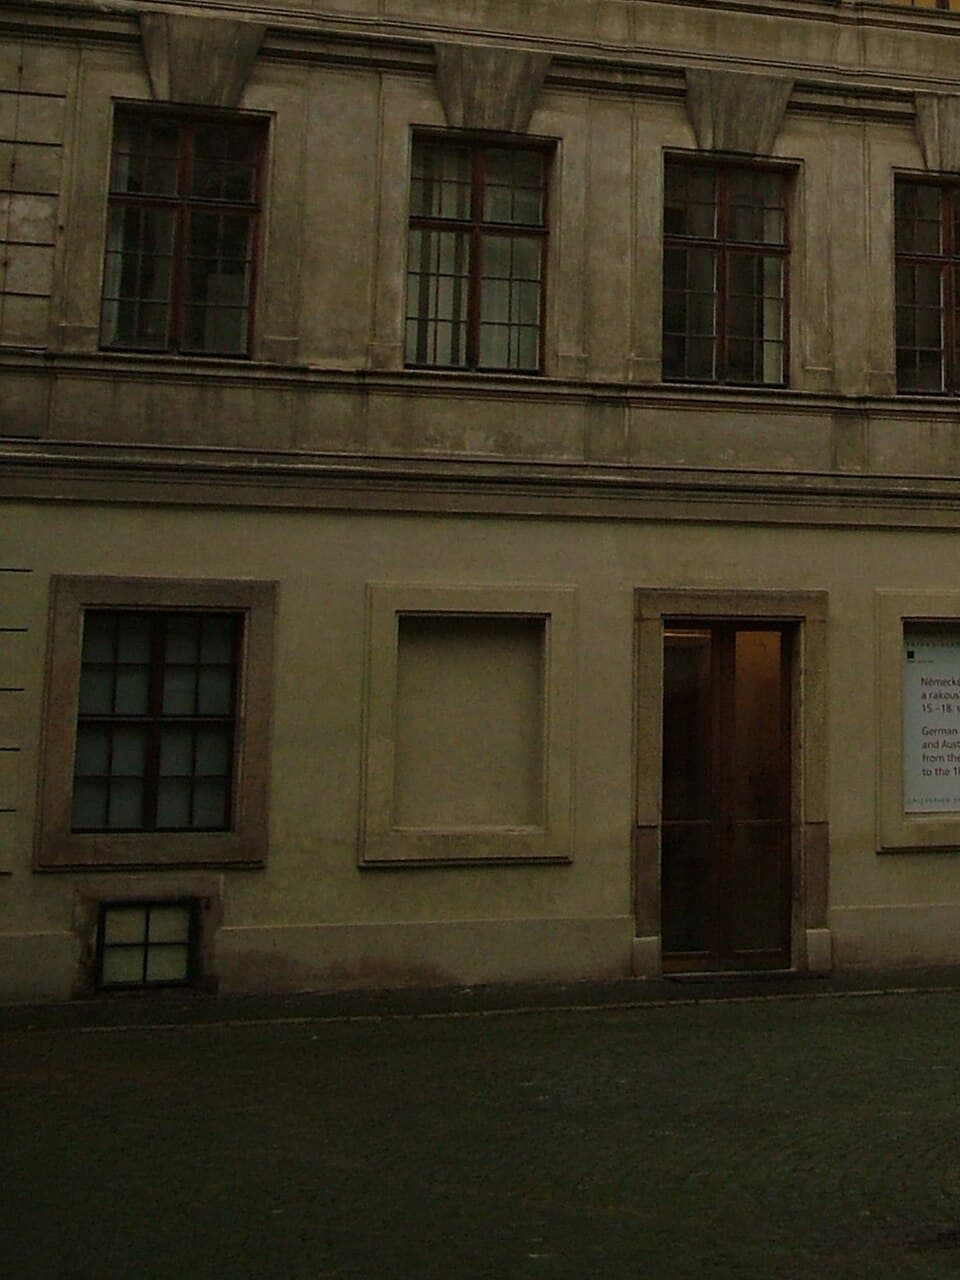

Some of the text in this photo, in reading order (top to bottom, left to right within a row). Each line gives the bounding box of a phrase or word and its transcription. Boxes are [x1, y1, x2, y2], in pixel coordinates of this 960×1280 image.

[921, 726, 958, 736] German
[921, 739, 939, 749] and
[922, 752, 945, 762] from
[921, 767, 932, 776] to
[934, 767, 950, 776] the
